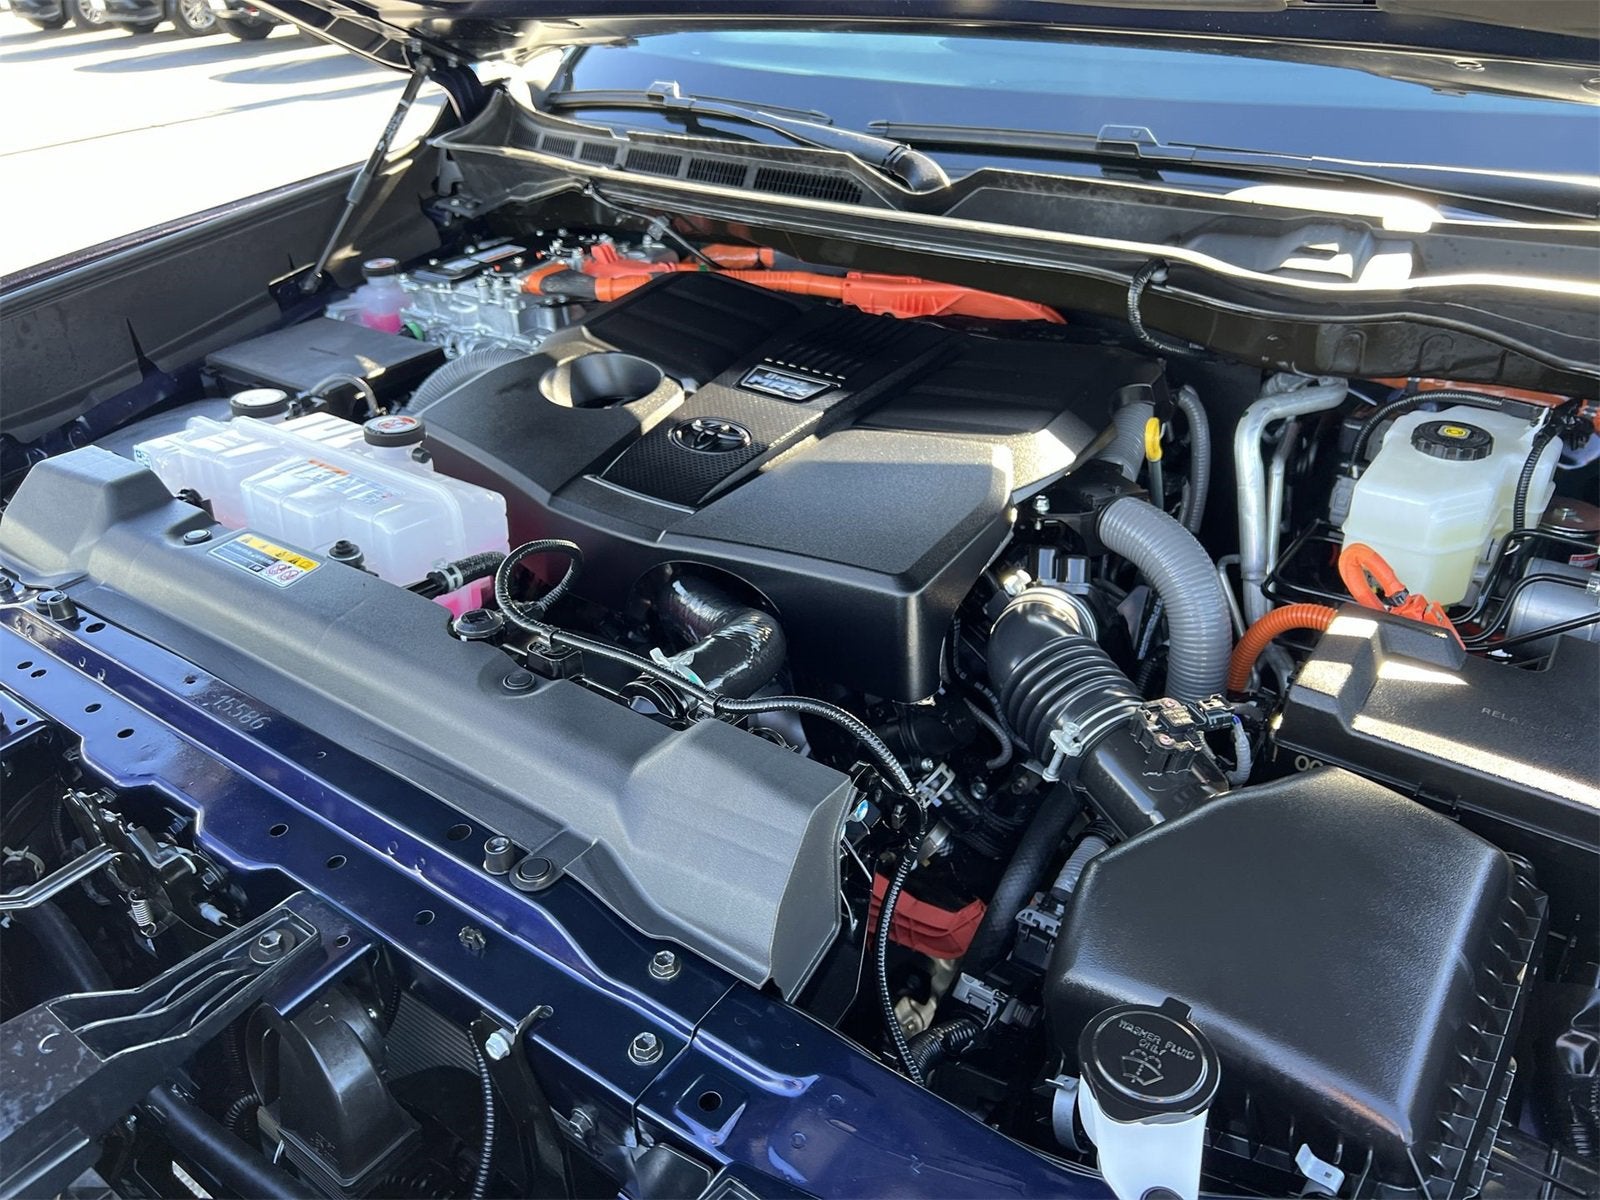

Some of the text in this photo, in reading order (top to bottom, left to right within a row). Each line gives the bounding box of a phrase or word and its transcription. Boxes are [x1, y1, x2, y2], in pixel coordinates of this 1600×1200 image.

[1119, 1020, 1196, 1061] WASHER FLUID
[1139, 1039, 1167, 1056] ONLY
